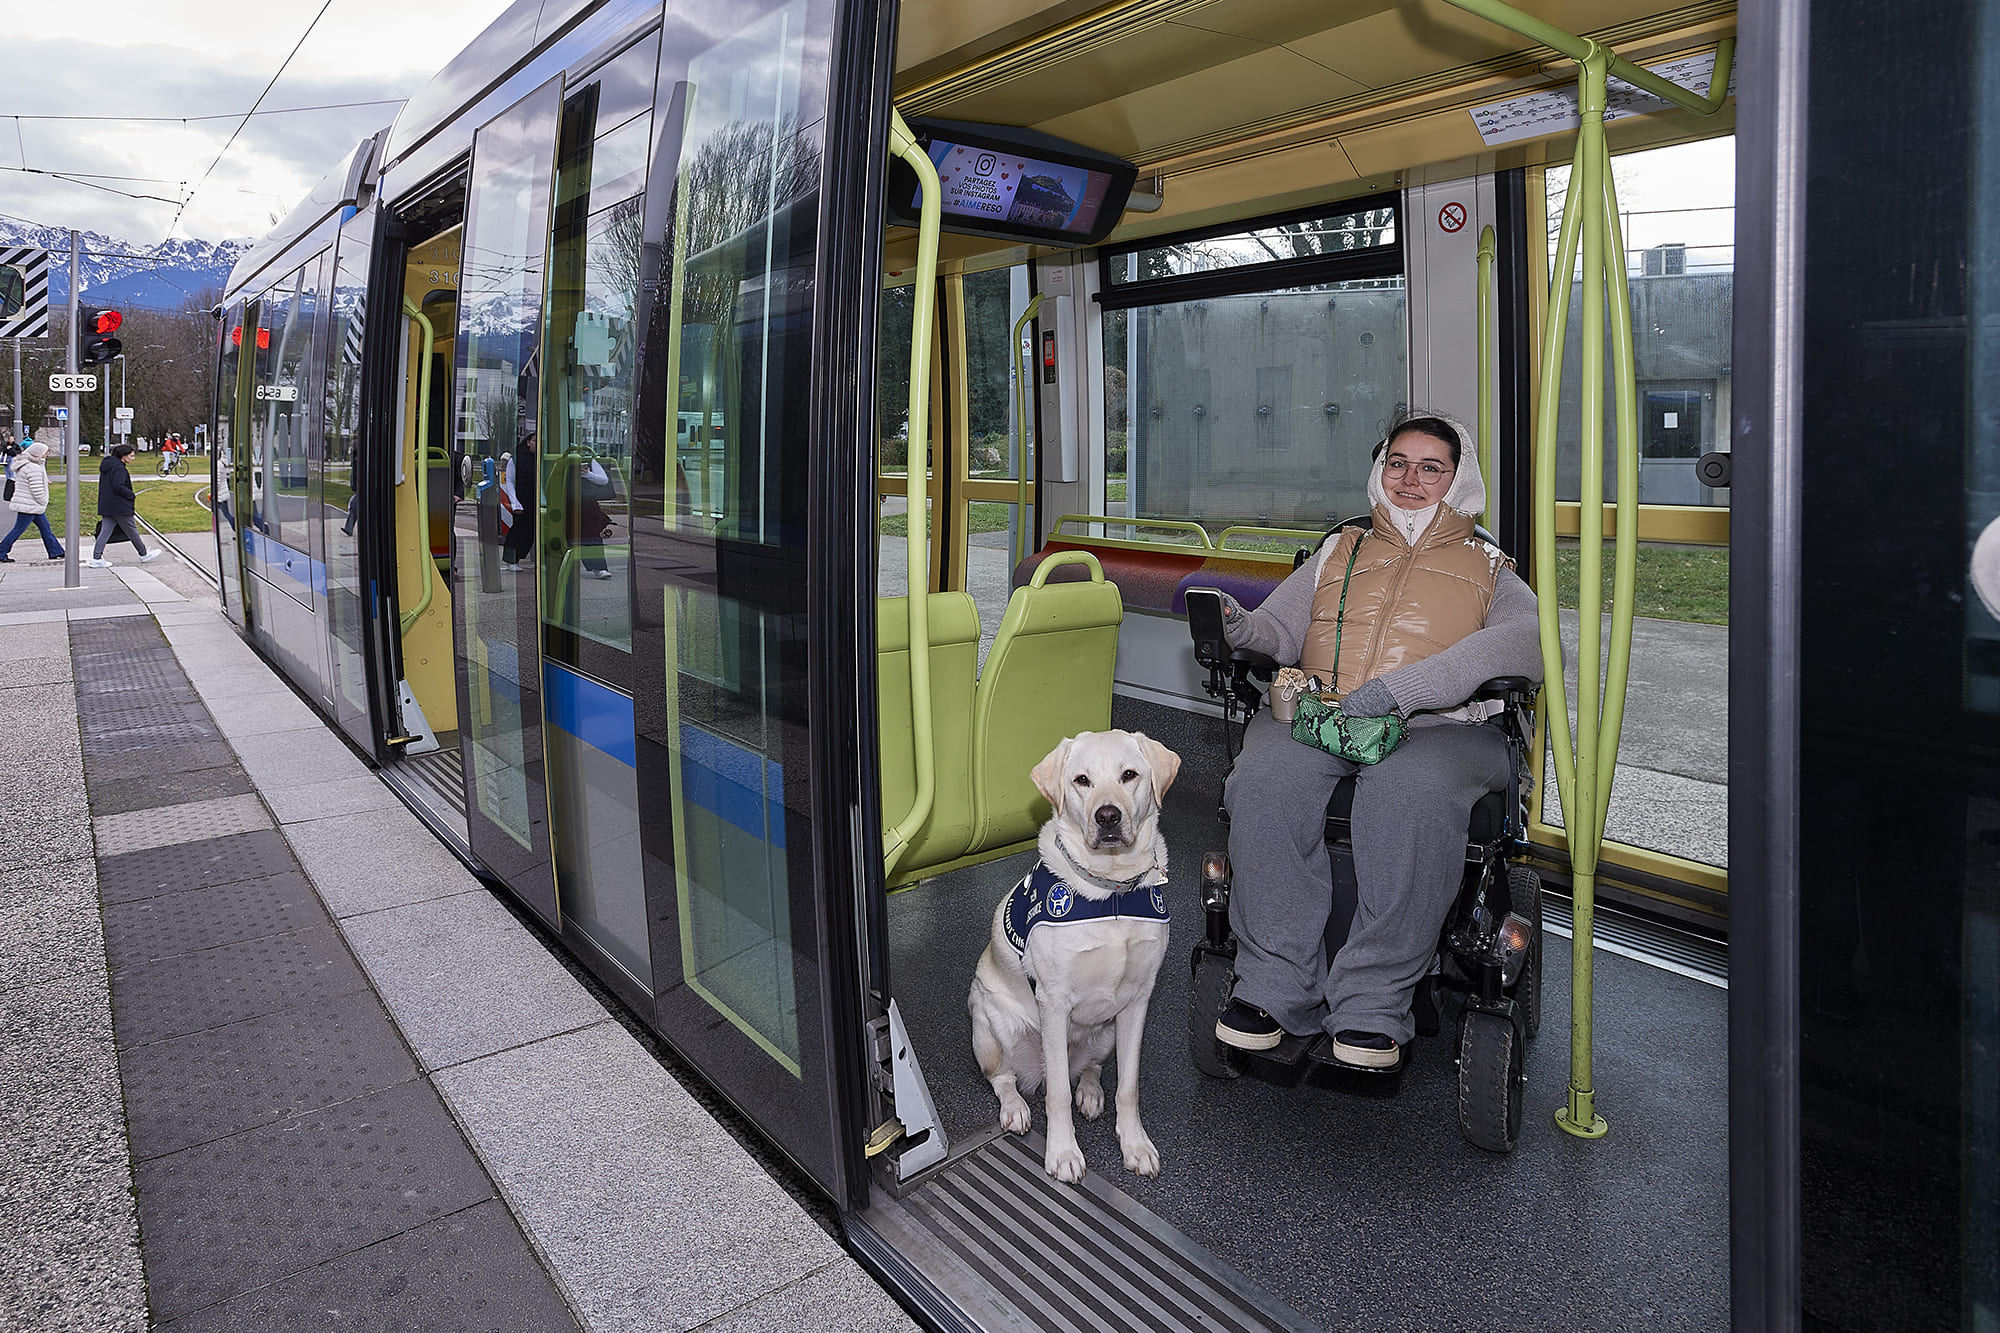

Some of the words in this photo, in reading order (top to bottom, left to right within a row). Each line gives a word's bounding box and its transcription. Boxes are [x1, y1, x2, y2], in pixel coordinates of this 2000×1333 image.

[964, 176, 996, 187] PARTAGEZ
[950, 187, 963, 195] SUR
[964, 190, 1001, 201] INSTAGRAM
[959, 182, 972, 190] VOS
[971, 184, 997, 194] PHOTOS
[953, 199, 1003, 213] #AIMERESO
[52, 377, 61, 389] S
[64, 377, 95, 389] 656
